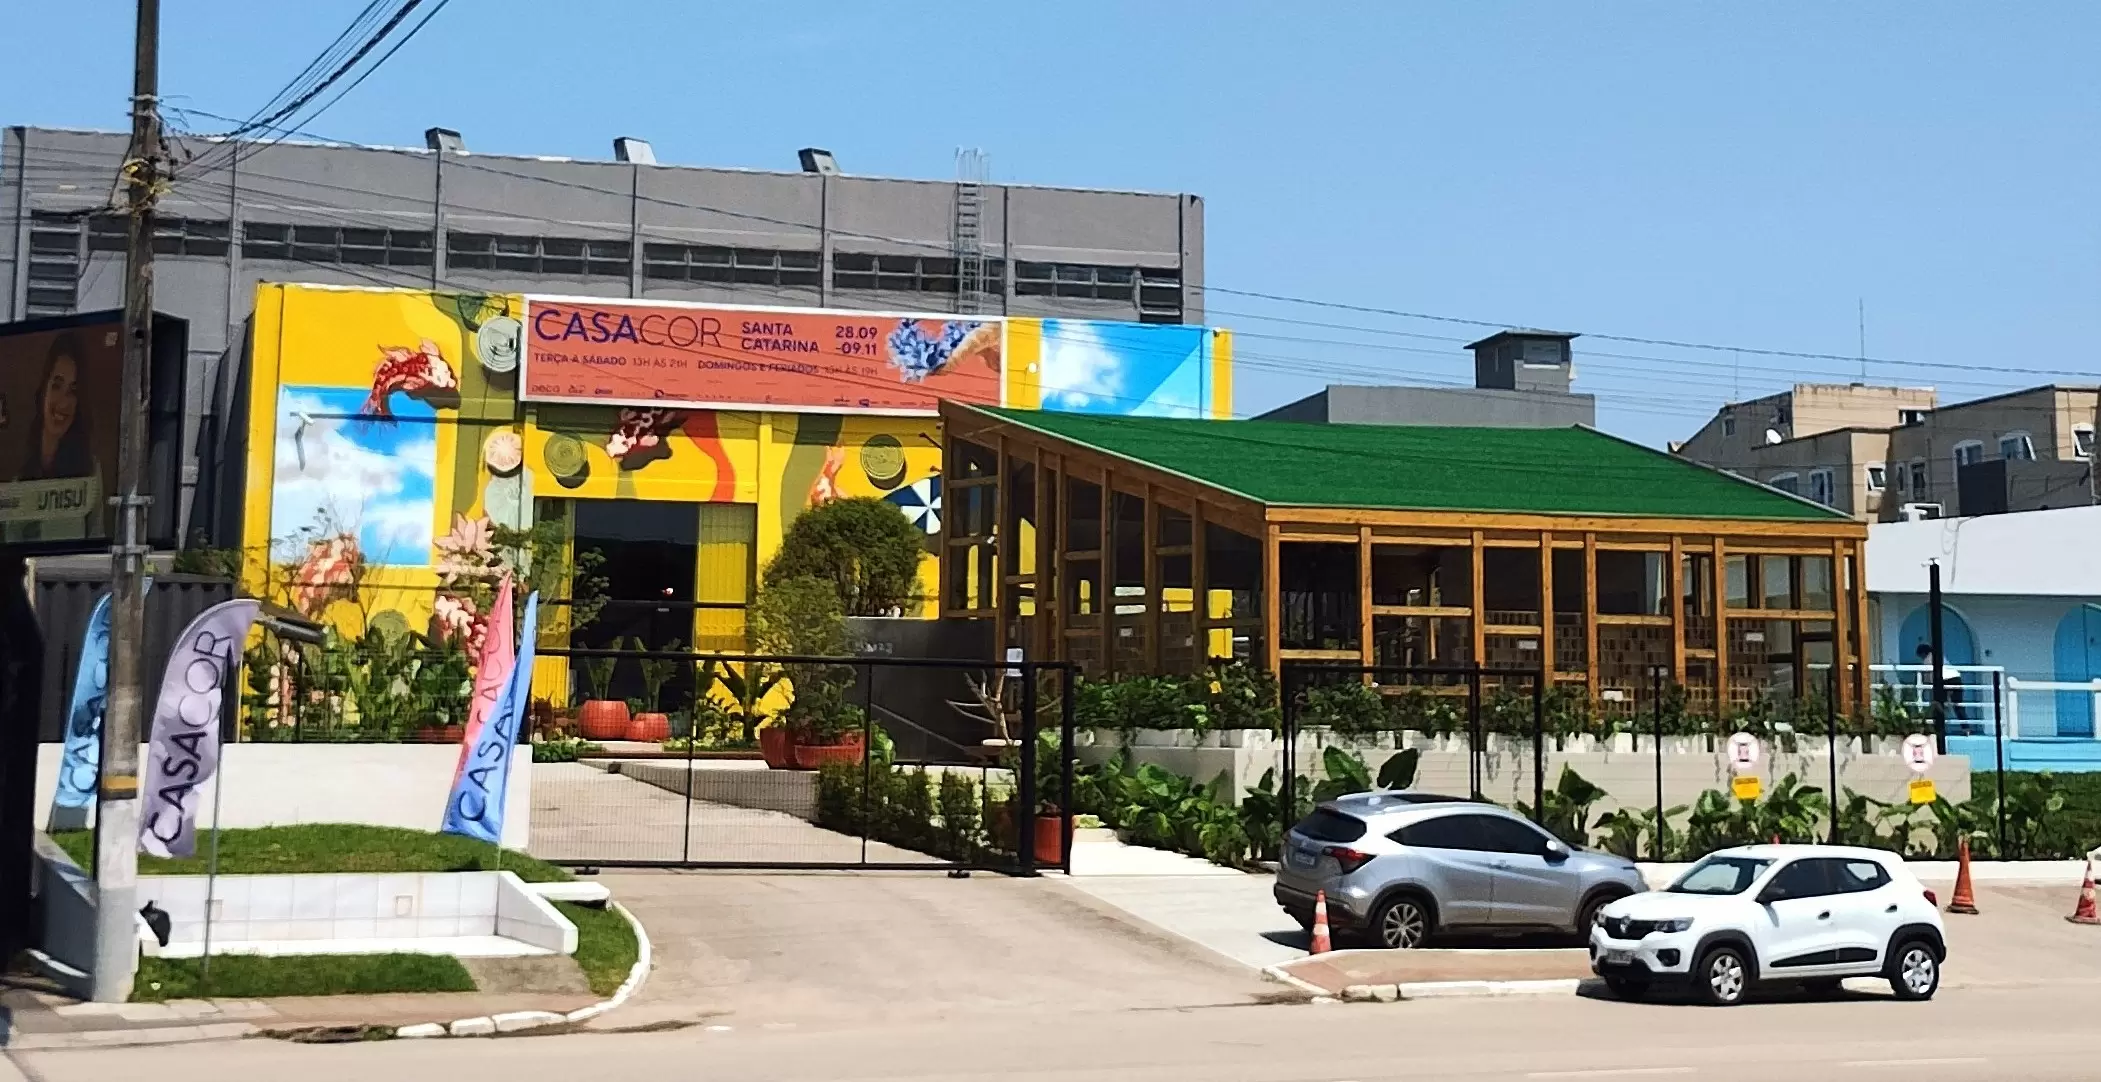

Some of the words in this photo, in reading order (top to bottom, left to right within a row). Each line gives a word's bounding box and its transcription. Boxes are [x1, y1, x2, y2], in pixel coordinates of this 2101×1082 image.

[535, 309, 722, 348] CASACOR
[742, 321, 793, 336] SANTA
[835, 325, 878, 339] 28.09
[741, 337, 820, 353] CATARINA
[835, 341, 877, 355] -09.11
[150, 630, 232, 843] CASACOR
